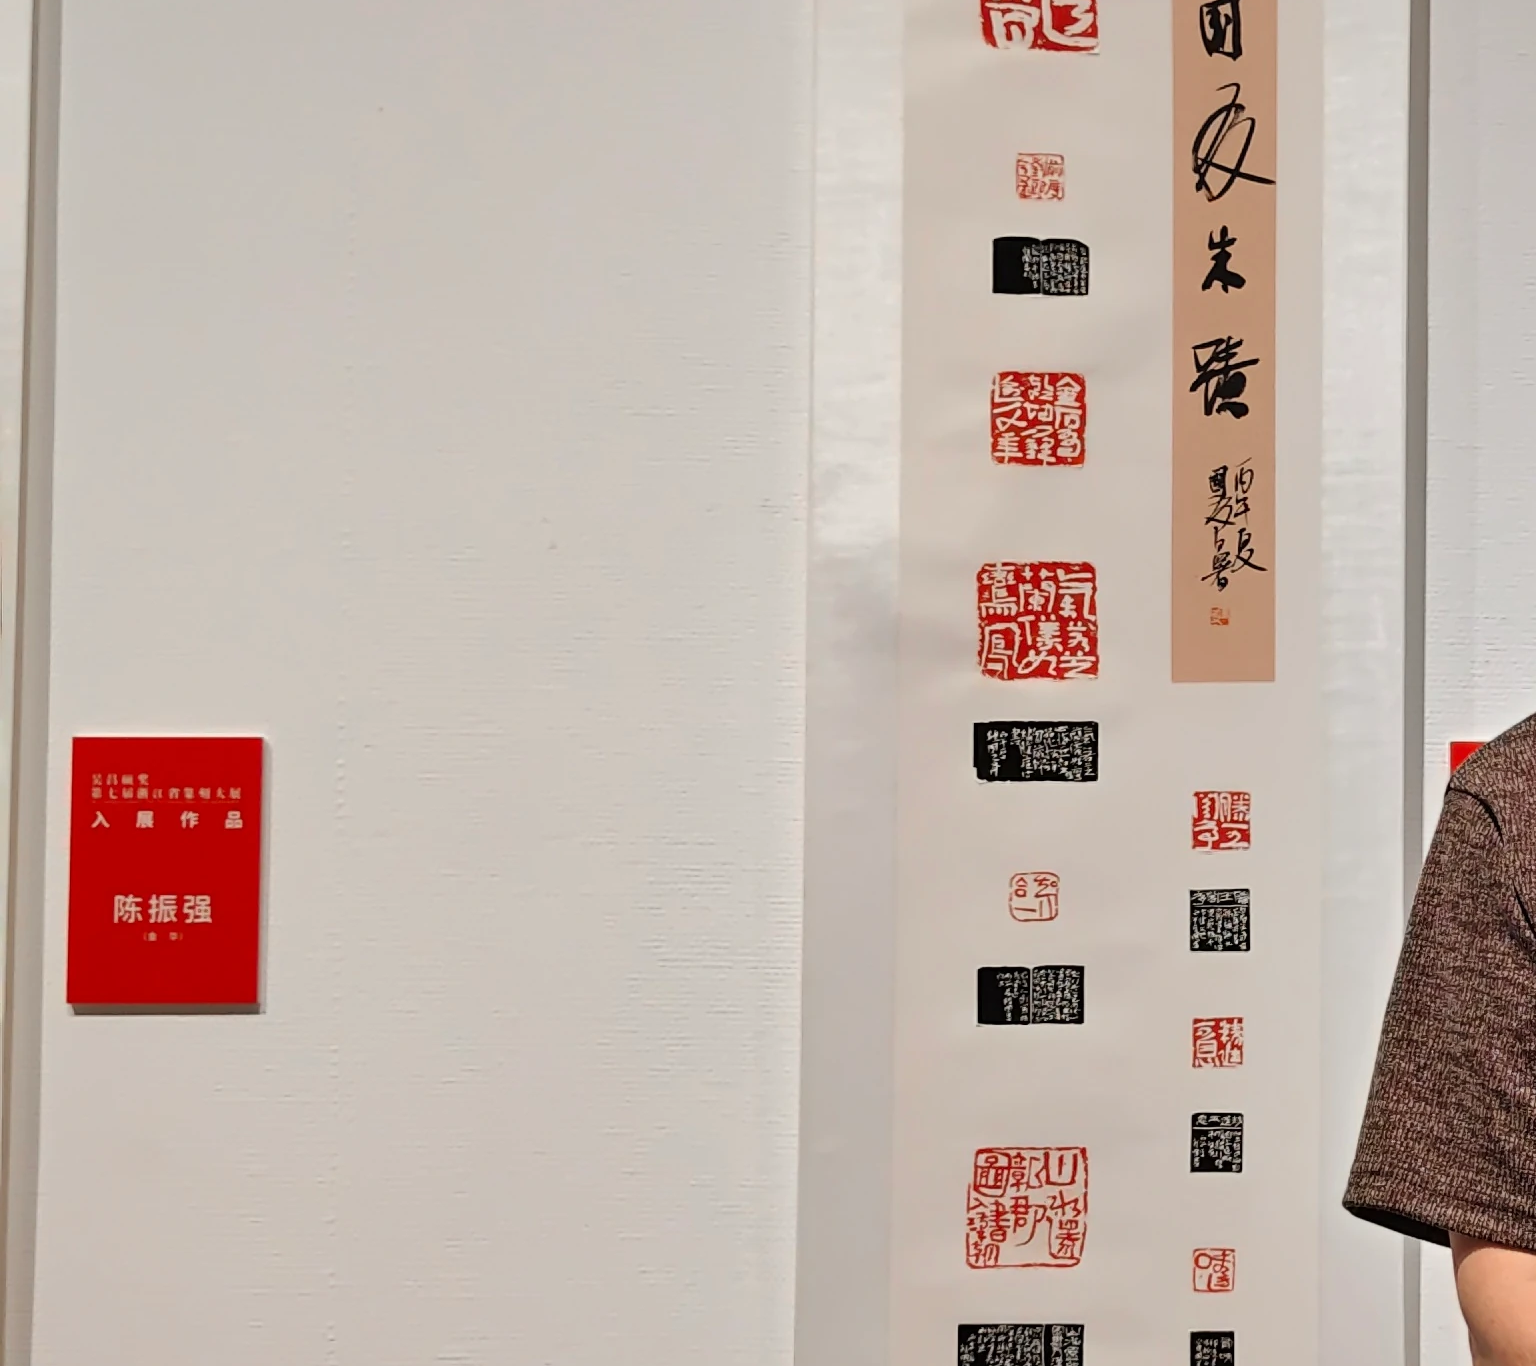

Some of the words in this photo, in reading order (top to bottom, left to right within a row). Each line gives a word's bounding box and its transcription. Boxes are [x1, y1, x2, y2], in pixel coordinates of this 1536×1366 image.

[91, 810, 243, 829] 入展作品
[113, 893, 213, 924] 陈振强
